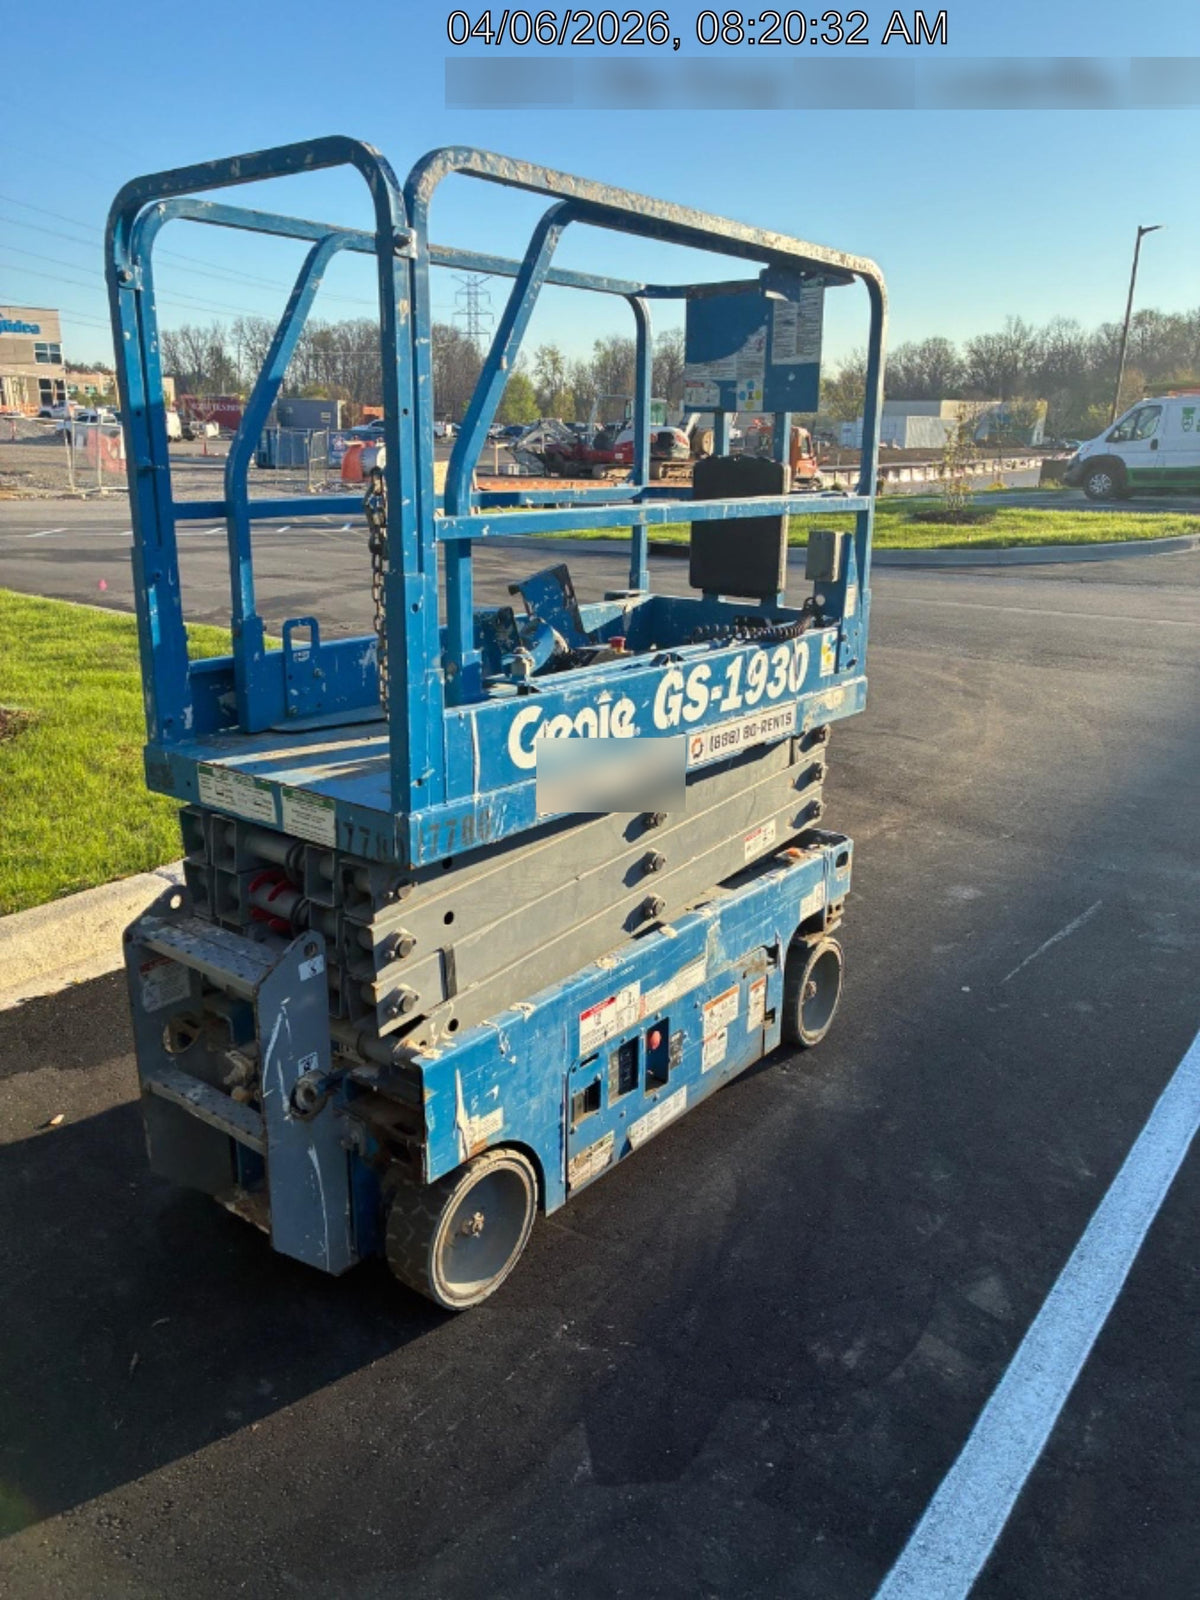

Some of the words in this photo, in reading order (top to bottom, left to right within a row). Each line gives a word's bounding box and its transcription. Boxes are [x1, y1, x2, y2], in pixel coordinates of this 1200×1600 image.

[508, 690, 636, 769] Genie
[653, 641, 809, 730] GS-1930
[710, 727, 740, 752] (888)
[743, 712, 792, 740] 80-RENTS
